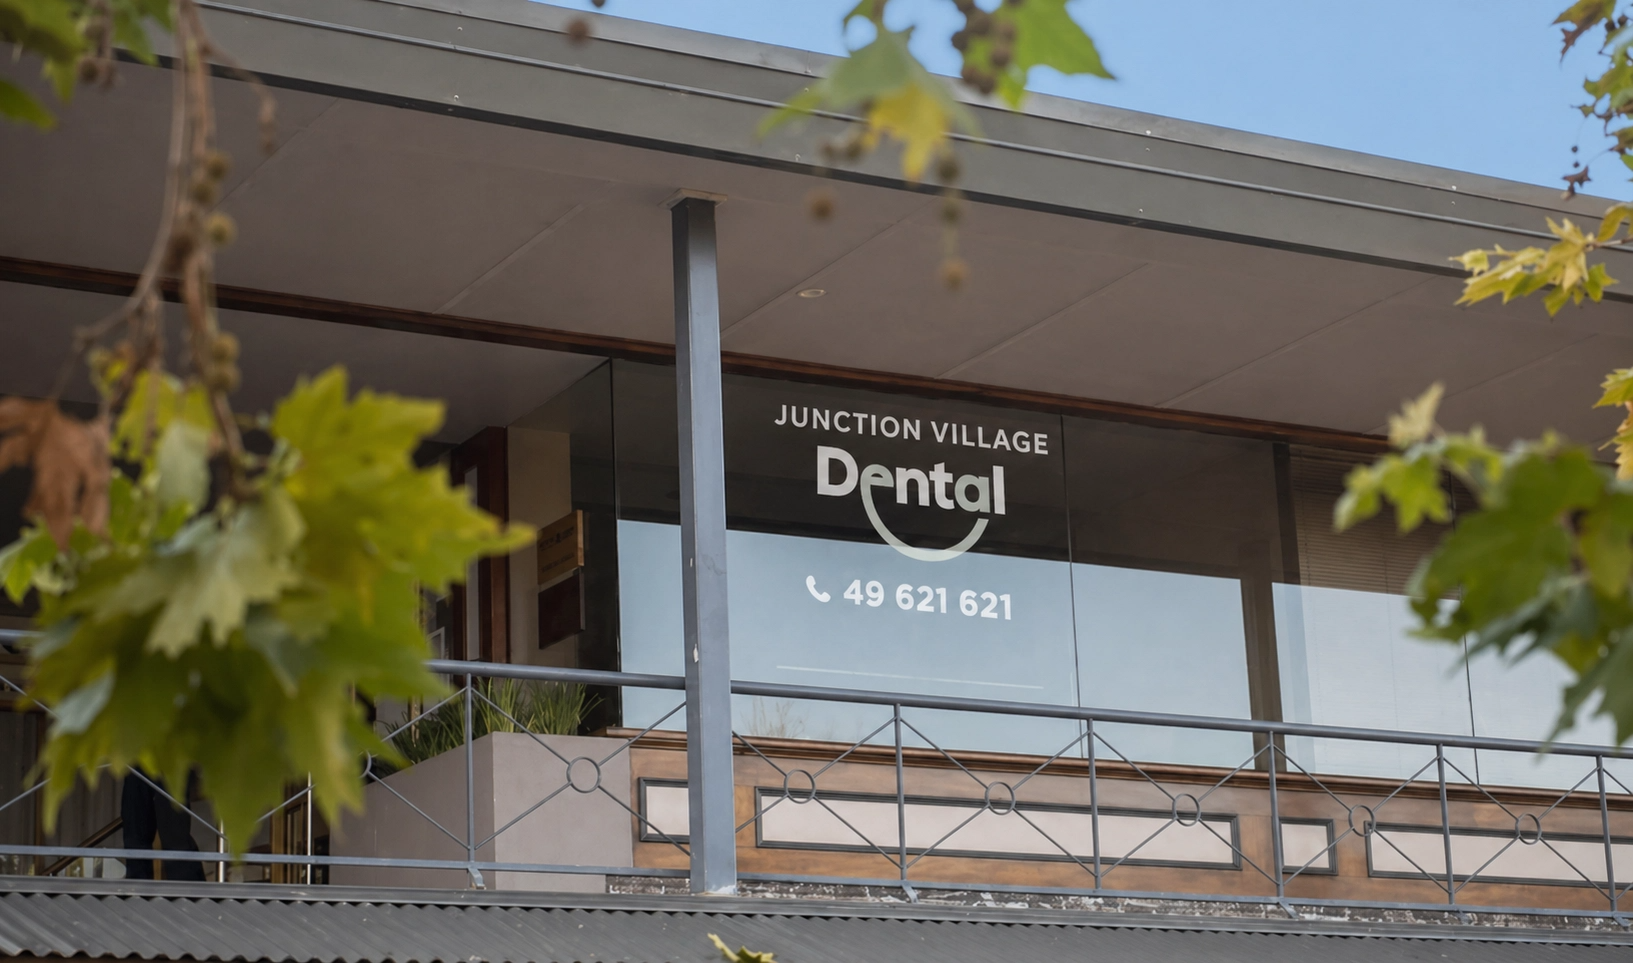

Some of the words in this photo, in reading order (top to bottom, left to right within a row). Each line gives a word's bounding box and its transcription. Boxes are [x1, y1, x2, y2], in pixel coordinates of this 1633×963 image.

[774, 404, 921, 441] JUNCTION
[930, 421, 1049, 455] VILLAGE
[816, 445, 1006, 562] Dental
[843, 579, 885, 608] 49
[895, 583, 947, 614] 621
[959, 590, 1012, 620] 621
